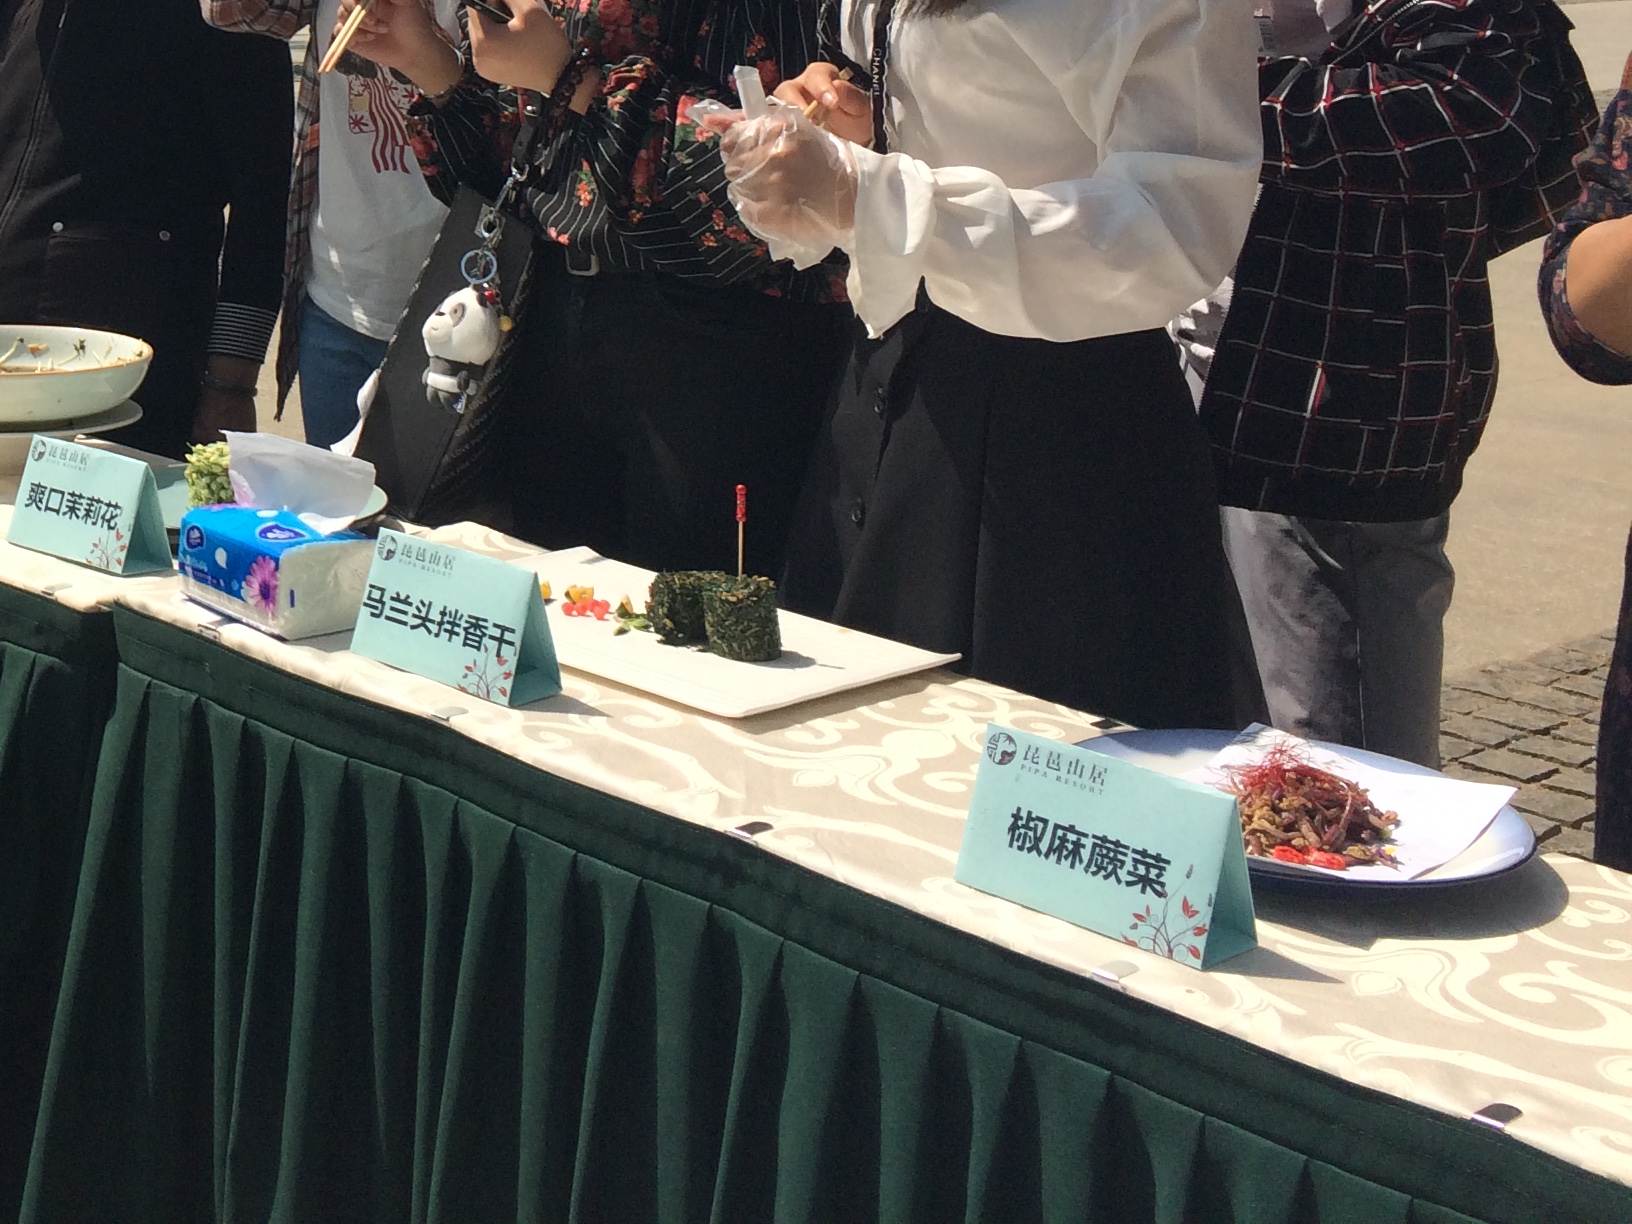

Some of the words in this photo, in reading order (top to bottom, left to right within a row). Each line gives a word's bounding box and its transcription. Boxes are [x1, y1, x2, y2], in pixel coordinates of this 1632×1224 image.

[872, 48, 884, 97] CHANEL
[24, 481, 122, 531] 爽口茉莉花
[362, 583, 517, 658] 马兰头拌香干
[1020, 763, 1048, 779] PIPA
[1055, 775, 1105, 796] RESORT
[1007, 806, 1172, 899] 椒麻蕨菜
